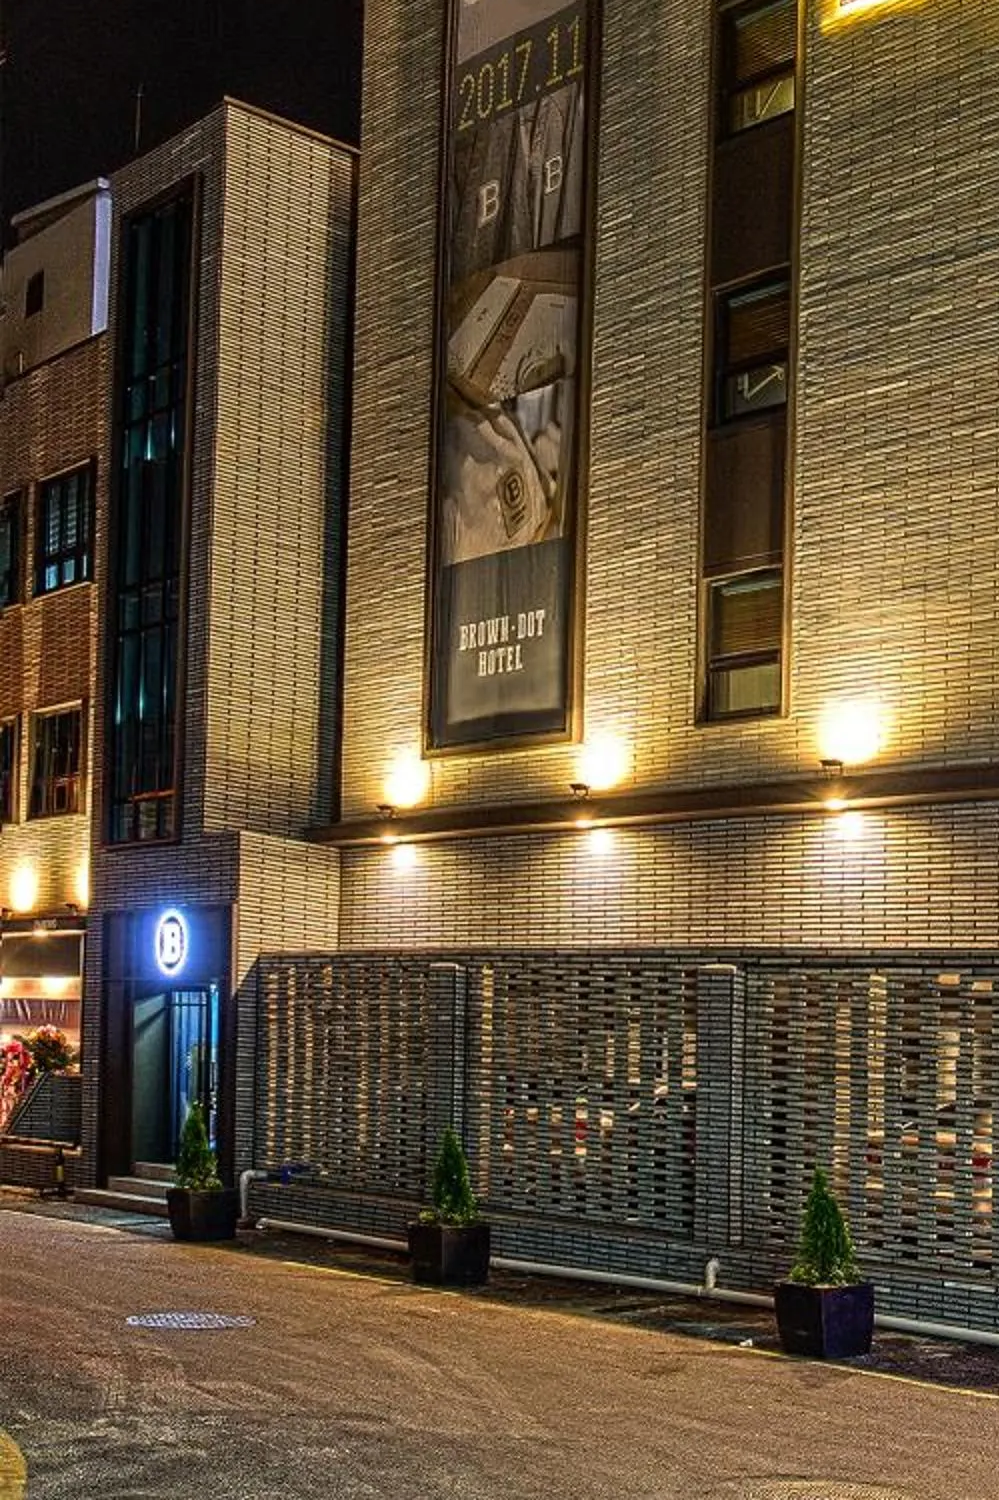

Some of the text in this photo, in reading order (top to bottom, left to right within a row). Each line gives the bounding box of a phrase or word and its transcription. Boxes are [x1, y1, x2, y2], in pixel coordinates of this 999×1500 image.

[544, 155, 563, 195] B
[479, 179, 500, 228] B
[478, 643, 523, 676] HOTEL
